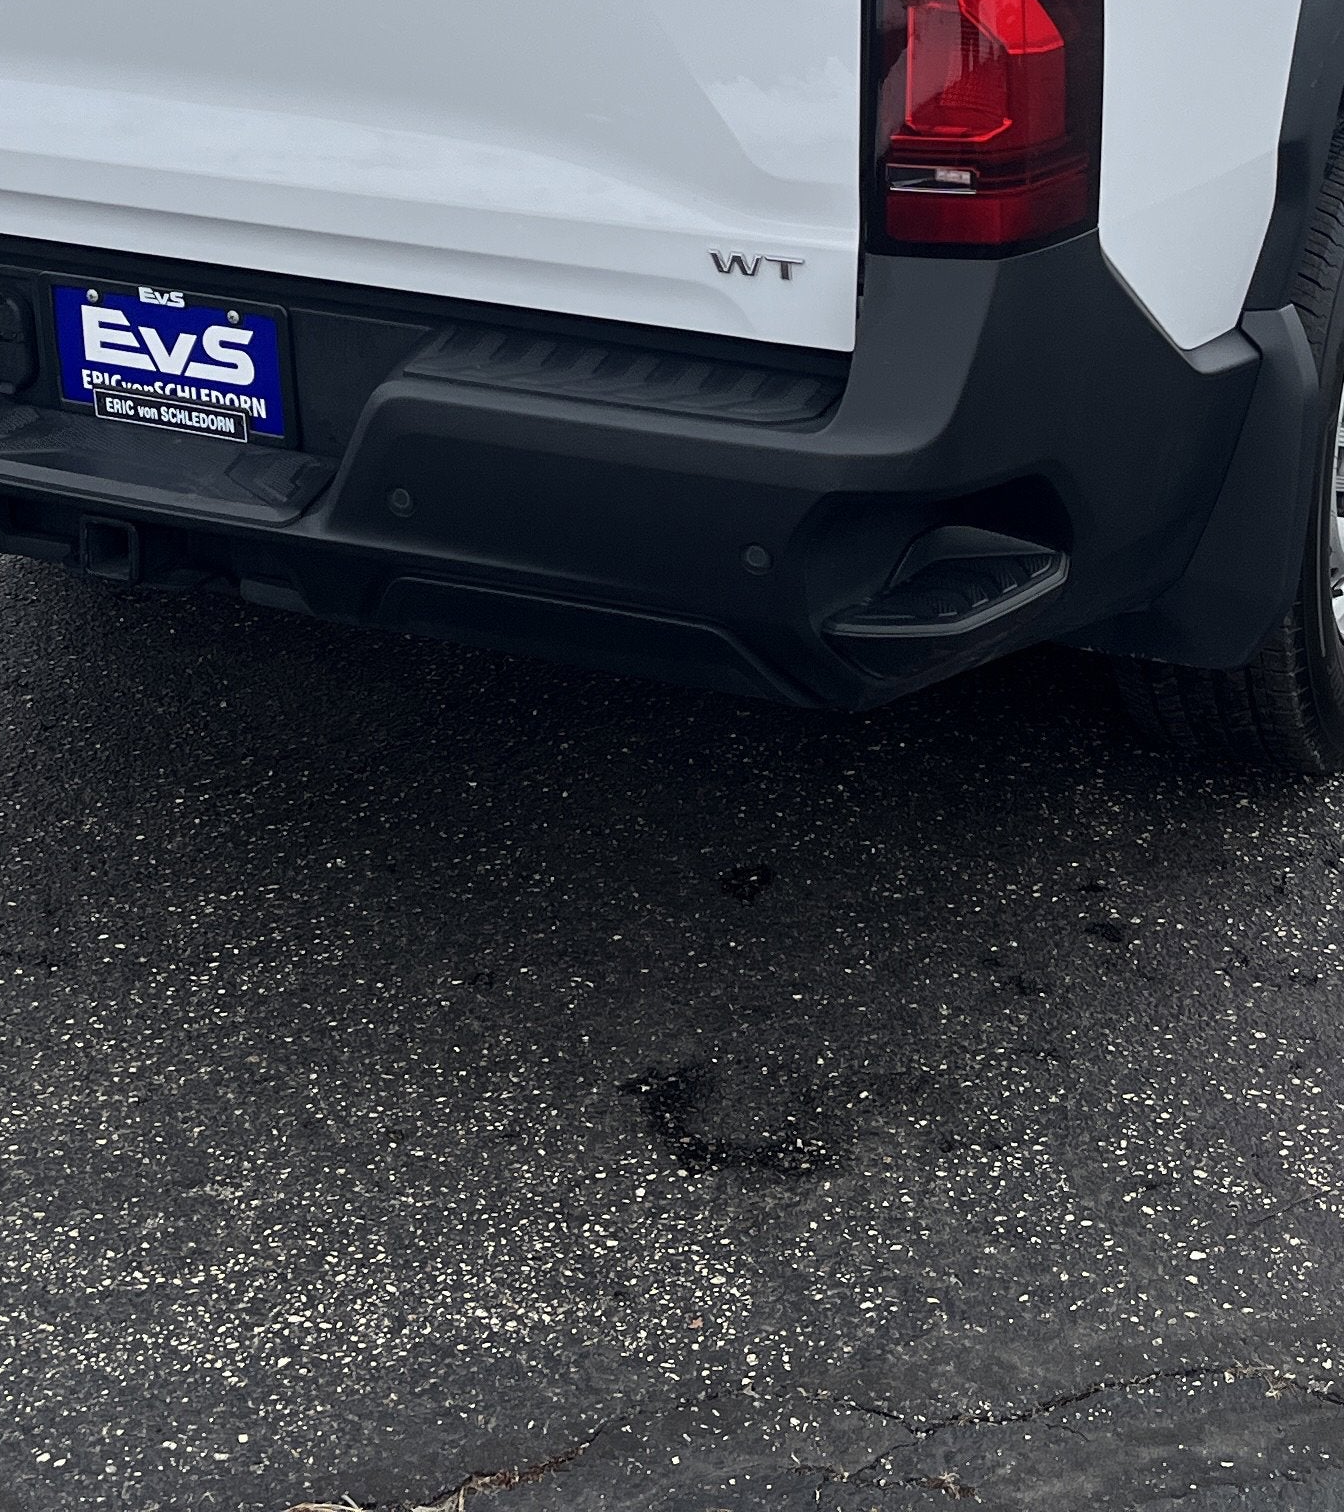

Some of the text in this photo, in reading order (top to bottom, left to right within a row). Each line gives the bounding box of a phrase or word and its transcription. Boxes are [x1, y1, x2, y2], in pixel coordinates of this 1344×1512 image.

[707, 249, 806, 281] WT
[105, 397, 235, 434] ERIC von SCHLEDORN
